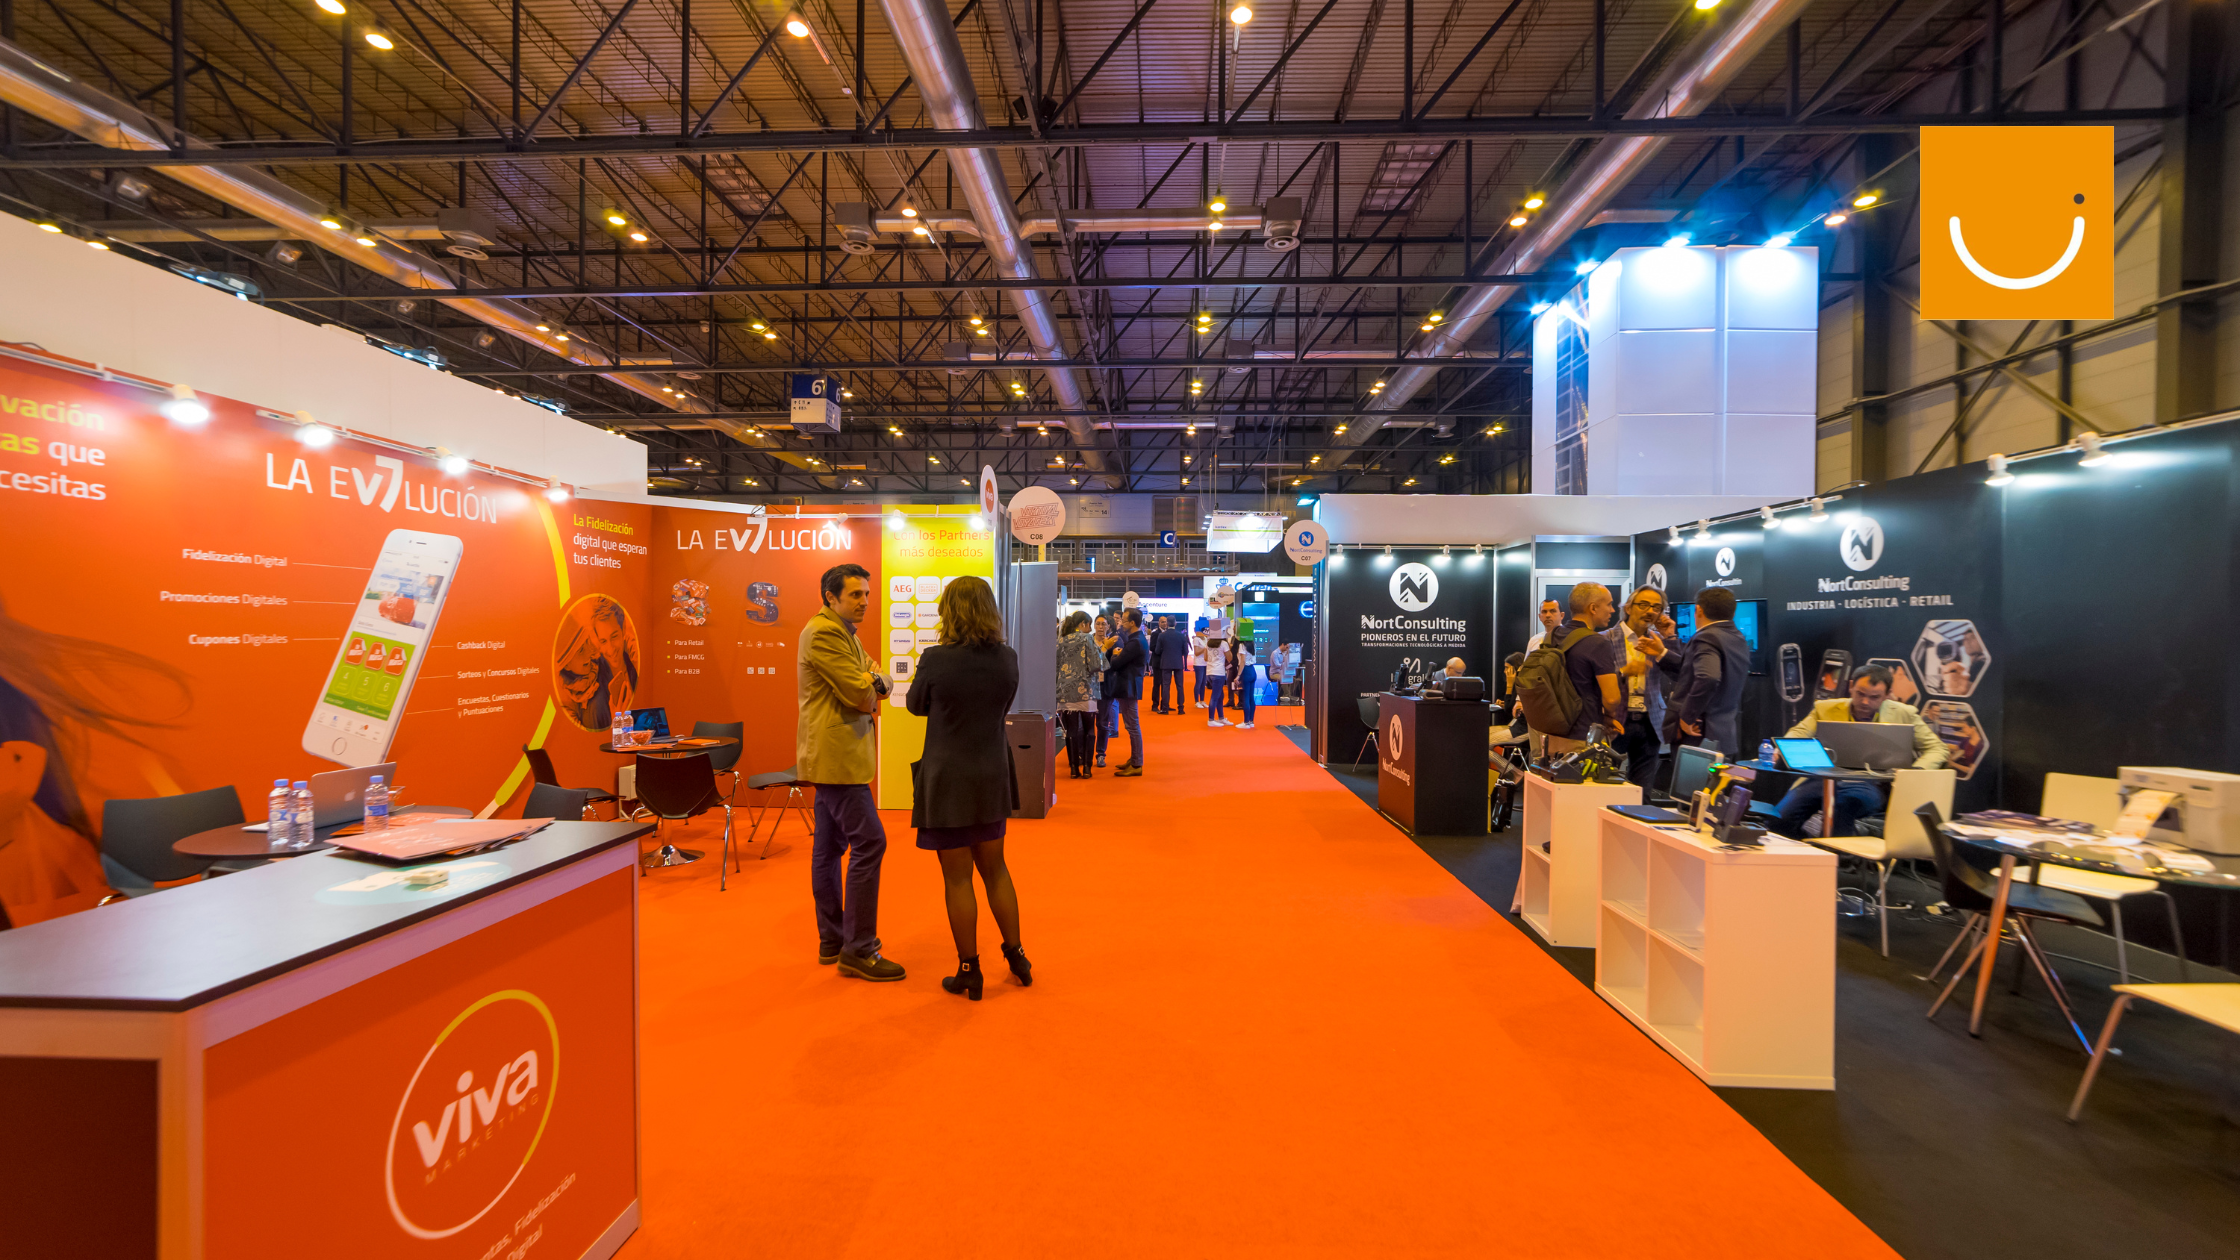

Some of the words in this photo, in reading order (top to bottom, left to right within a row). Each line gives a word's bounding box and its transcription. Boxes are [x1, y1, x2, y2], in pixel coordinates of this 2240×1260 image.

[812, 379, 822, 396] 6
[0, 432, 40, 455] as
[48, 441, 106, 466] que
[266, 452, 313, 494] LA
[574, 514, 584, 526] La
[586, 516, 634, 536] Fidelización
[677, 530, 704, 550] LA
[919, 530, 936, 540] los
[940, 530, 990, 540] Partners
[574, 532, 600, 550] digital
[602, 540, 617, 552] que
[618, 542, 648, 556] esperan
[900, 546, 924, 557] más
[928, 546, 984, 557] deseados
[182, 548, 252, 564] Fidelización
[254, 554, 288, 568] Digital
[574, 552, 588, 564] tus
[590, 554, 622, 568] clientes
[894, 584, 912, 592] AEG
[1818, 575, 1910, 593] NortConsulting
[160, 590, 240, 604] Promociones
[242, 594, 288, 607] Digitales
[1786, 600, 1836, 610] INDUSTRIA
[1844, 596, 1899, 608] LOGÍSTICA
[1910, 595, 1954, 606] RETAIL
[1361, 614, 1466, 632] NortConsulting
[188, 634, 240, 647] Cupones
[242, 634, 288, 646] Digitales
[457, 642, 486, 650] Cashback
[488, 641, 506, 650] Digital
[1361, 634, 1404, 642] PIONEROS
[1406, 634, 1418, 642] EN
[1420, 634, 1430, 642] EL
[1432, 634, 1466, 642] FUTURO
[458, 671, 482, 679] Sorteos
[517, 667, 540, 676] Digitales
[458, 696, 490, 706] Encuestas,
[492, 692, 529, 702] Cuestionarios
[463, 706, 504, 716] Puntuaciones
[412, 1049, 538, 1168] viva
[424, 1093, 540, 1186] MARKETING
